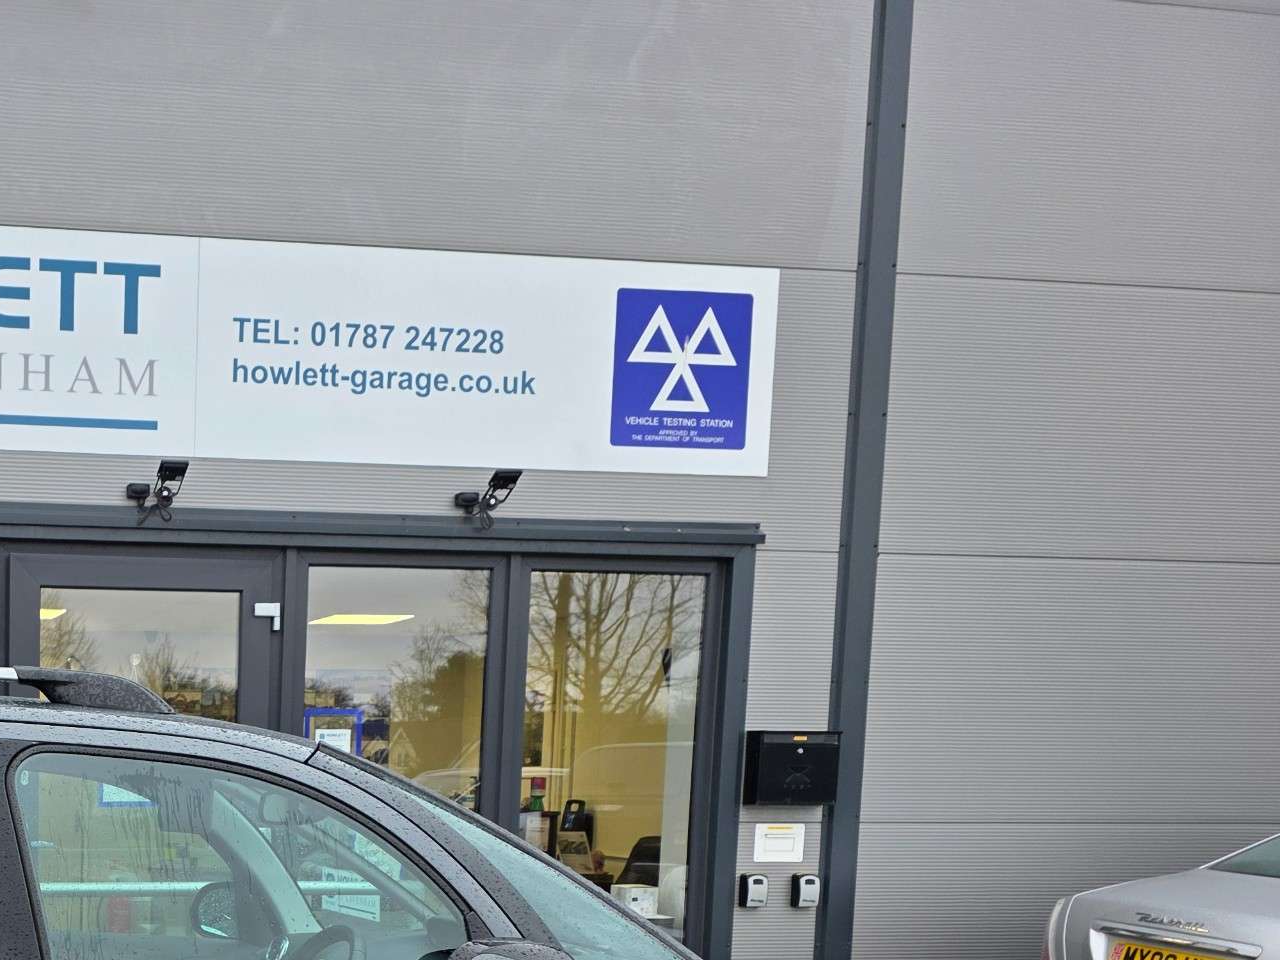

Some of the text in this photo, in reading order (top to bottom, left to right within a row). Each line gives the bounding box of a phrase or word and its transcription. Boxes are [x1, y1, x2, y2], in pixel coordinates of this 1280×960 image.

[232, 317, 504, 354] TEL: 01787 247228
[232, 358, 536, 397] howlett-garage.co.uk
[625, 416, 734, 428] VEHICLE TESTING STATION
